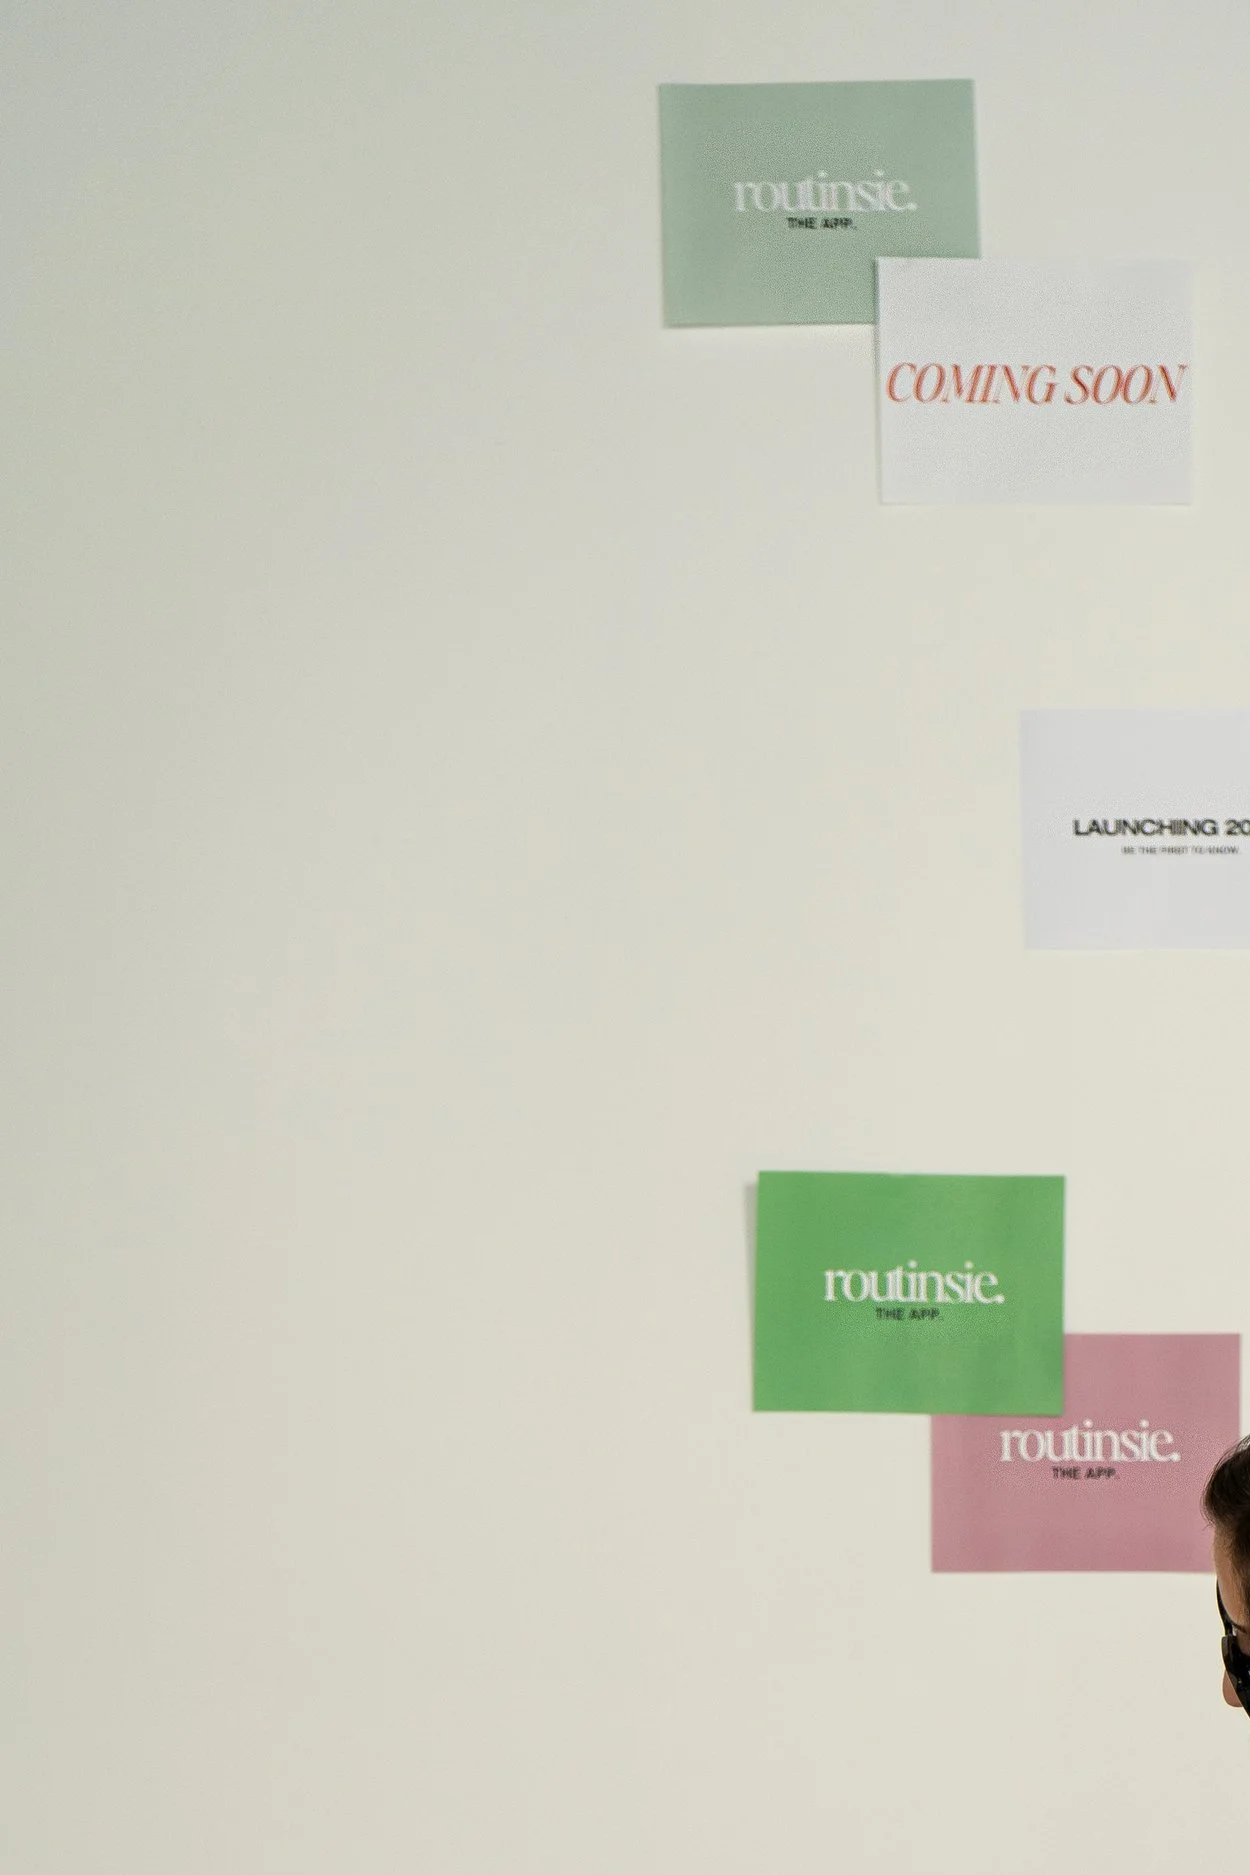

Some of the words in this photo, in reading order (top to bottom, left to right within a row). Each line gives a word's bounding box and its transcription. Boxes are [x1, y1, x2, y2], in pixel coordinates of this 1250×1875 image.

[734, 170, 917, 213] routinsie.
[787, 217, 815, 230] THE
[886, 362, 1057, 406] COMING
[1064, 364, 1188, 405] SOON
[1074, 817, 1218, 836] LAUNCHING
[824, 1260, 1005, 1304] routinsie.
[875, 1308, 904, 1321] THE
[1000, 1420, 1181, 1463] routinsie.
[1052, 1467, 1080, 1480] THE
